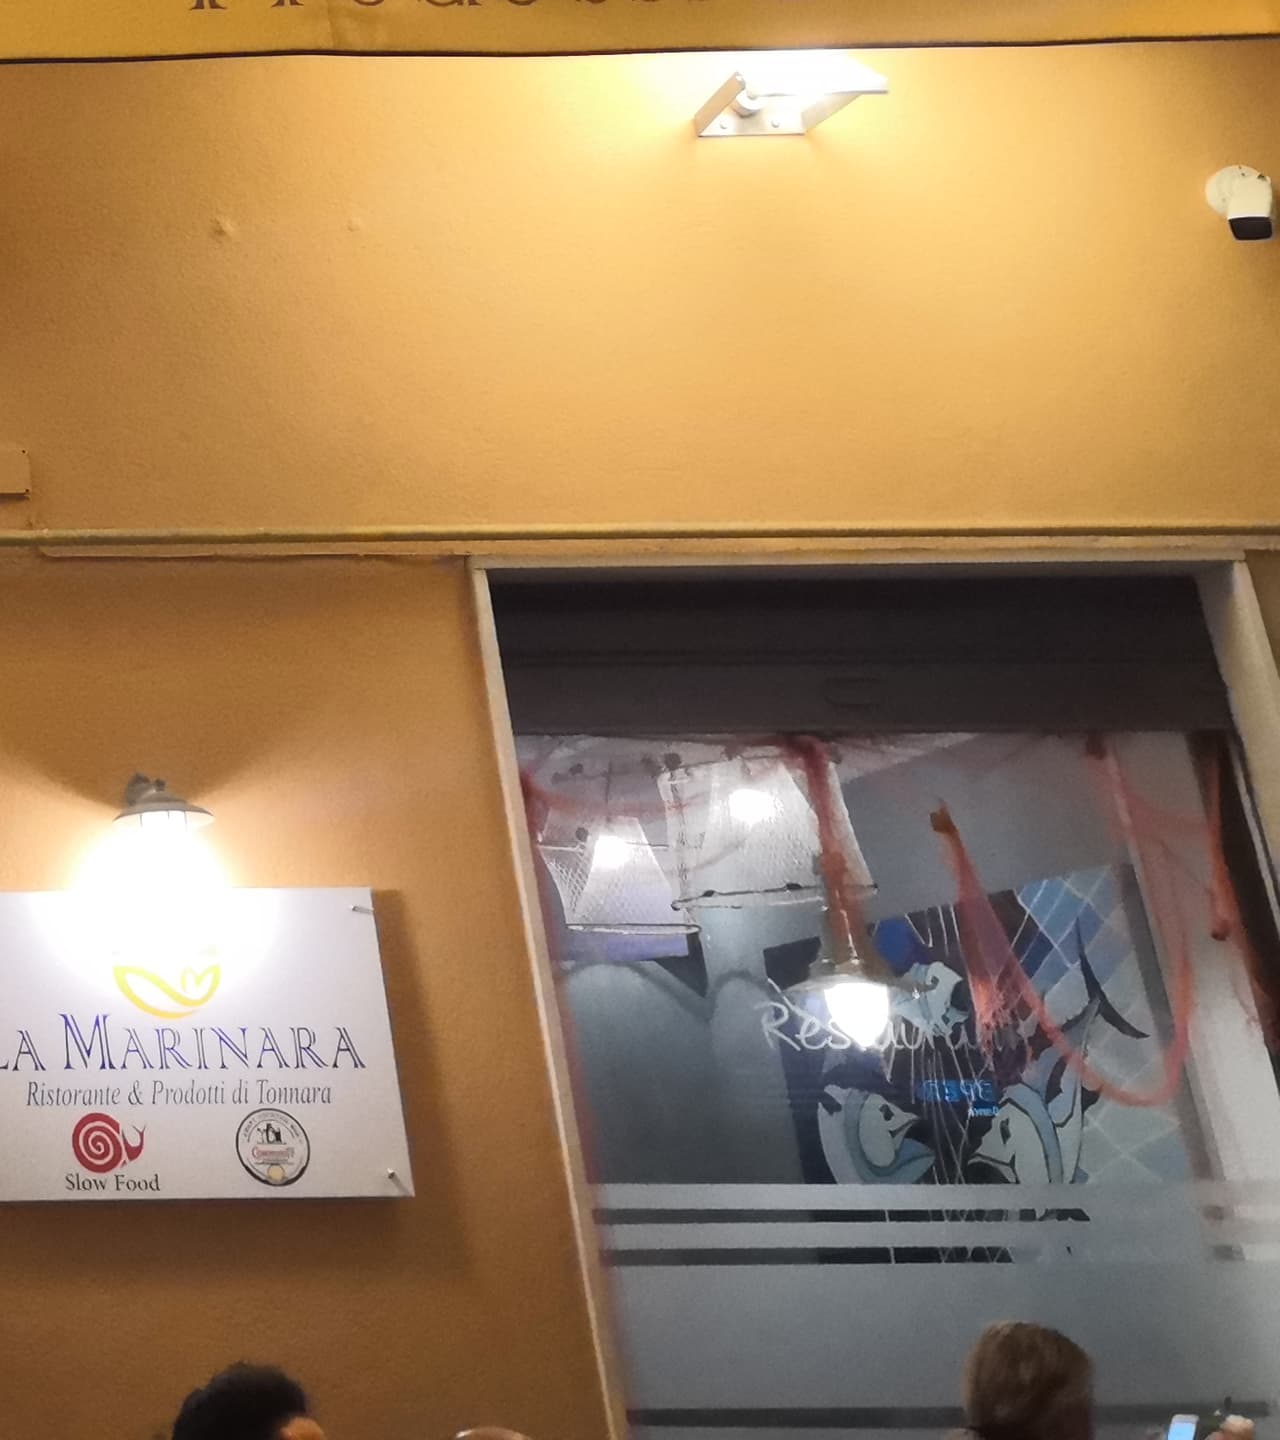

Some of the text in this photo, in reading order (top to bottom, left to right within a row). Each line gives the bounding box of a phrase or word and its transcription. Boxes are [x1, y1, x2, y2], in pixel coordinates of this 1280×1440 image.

[59, 1013, 367, 1072] MARINARA
[26, 1078, 332, 1107] Ristorante & Prodotti di Tonnara
[64, 1172, 161, 1192] Slow Food
